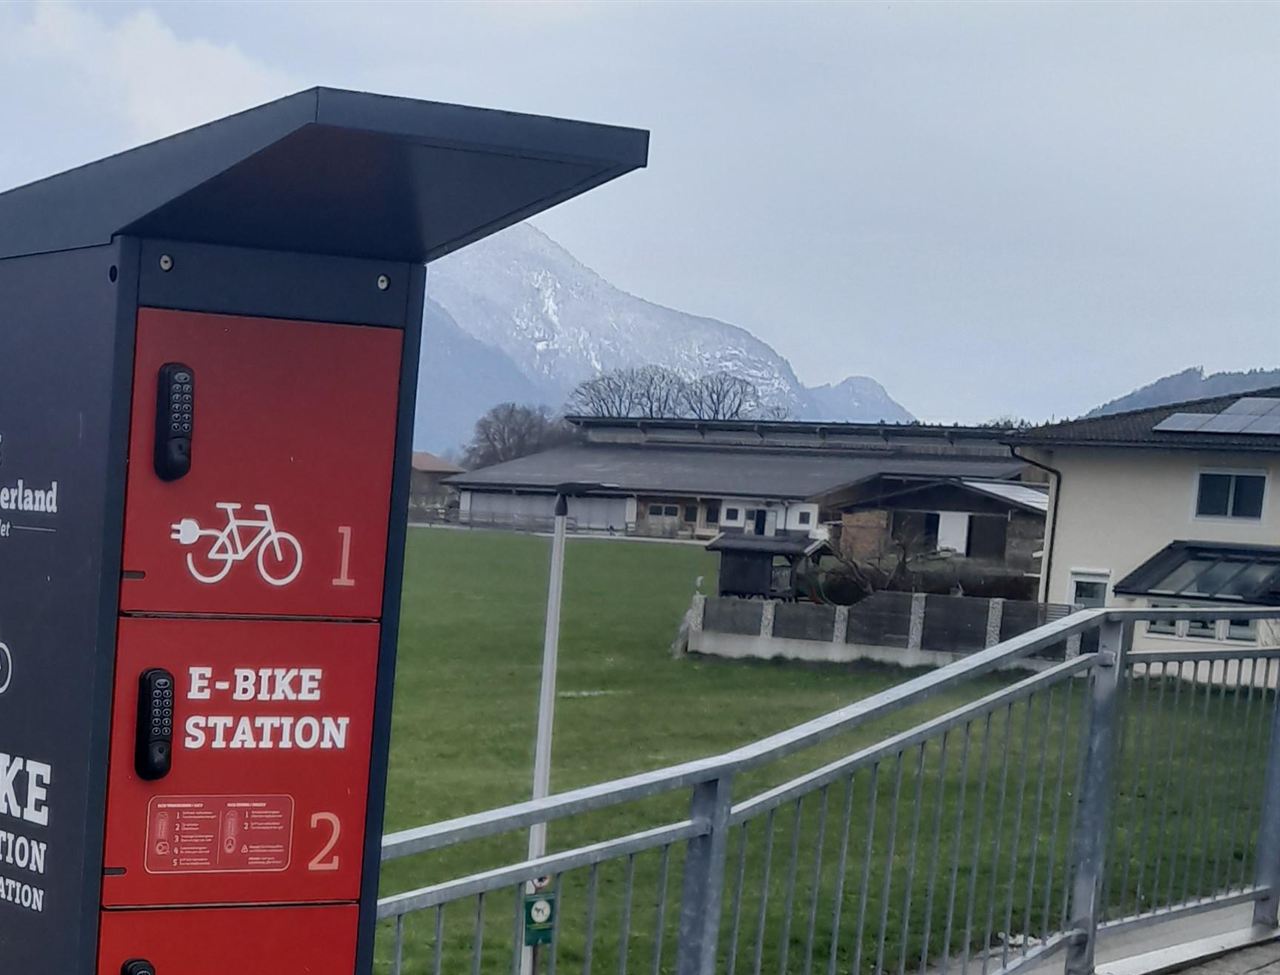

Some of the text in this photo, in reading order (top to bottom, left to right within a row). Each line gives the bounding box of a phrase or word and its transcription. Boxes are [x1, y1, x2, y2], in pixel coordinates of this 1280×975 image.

[332, 526, 355, 586] 1
[187, 666, 322, 701] E-BIKE
[184, 715, 350, 750] STATION
[308, 811, 341, 871] 2
